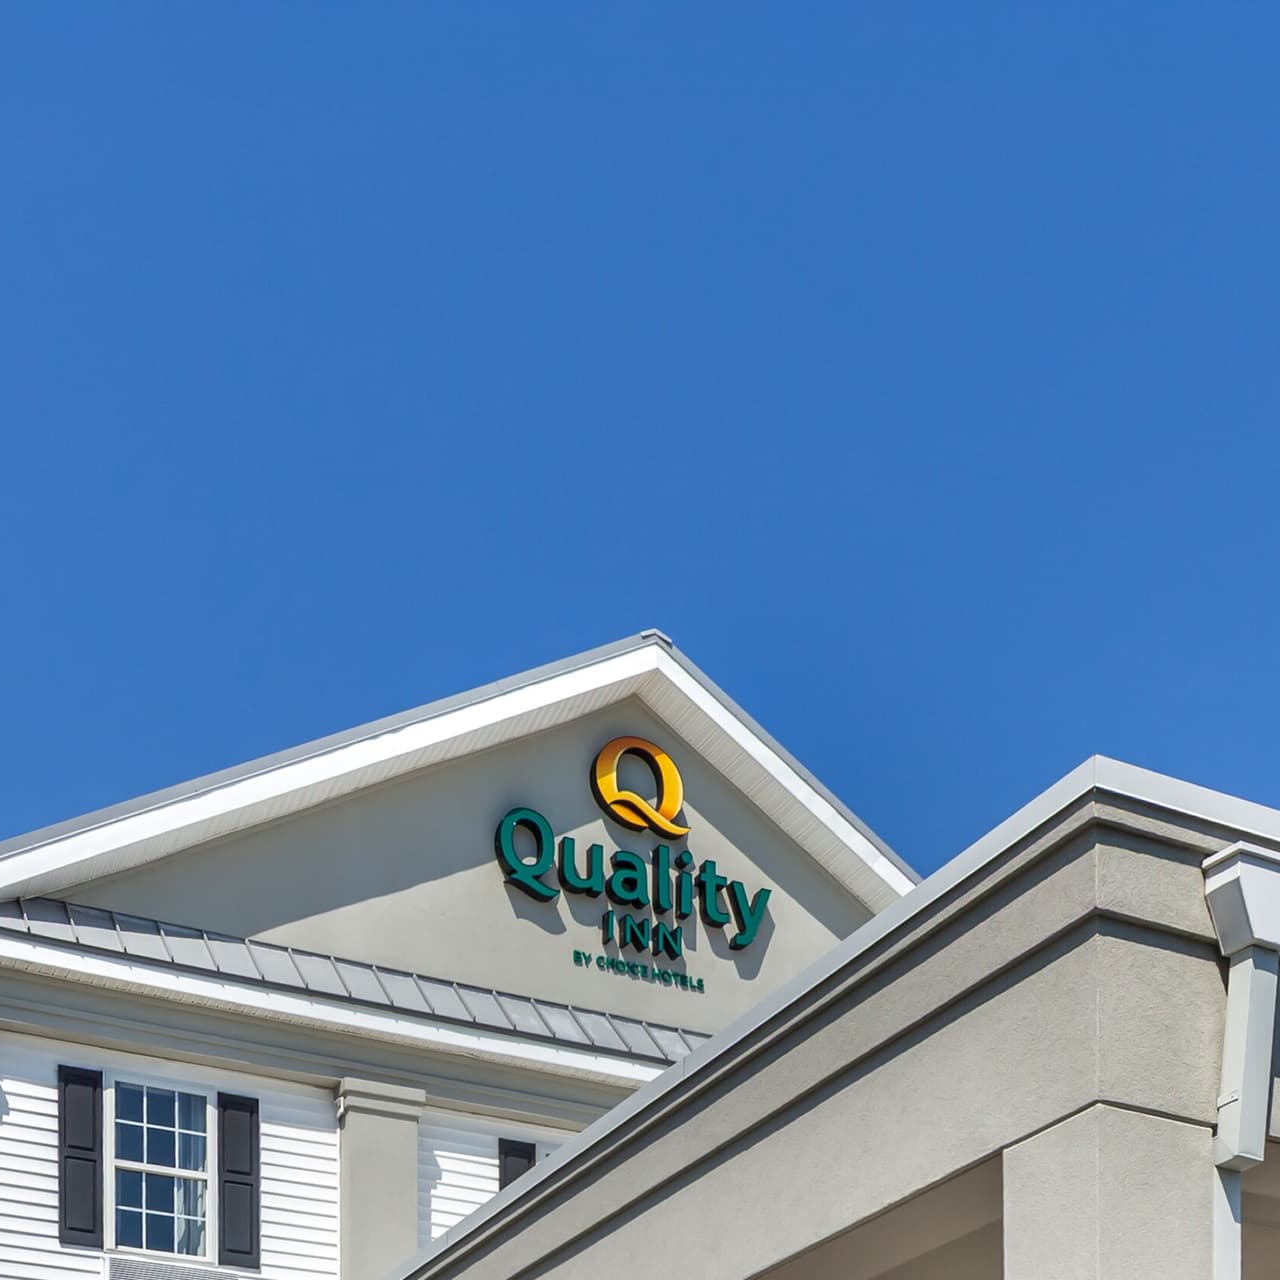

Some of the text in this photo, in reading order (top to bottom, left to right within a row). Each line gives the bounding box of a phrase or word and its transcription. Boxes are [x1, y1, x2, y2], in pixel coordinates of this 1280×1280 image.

[494, 807, 772, 950] Quality
[602, 909, 682, 960] INN
[573, 949, 704, 993] BY CHOICE HOTELS
